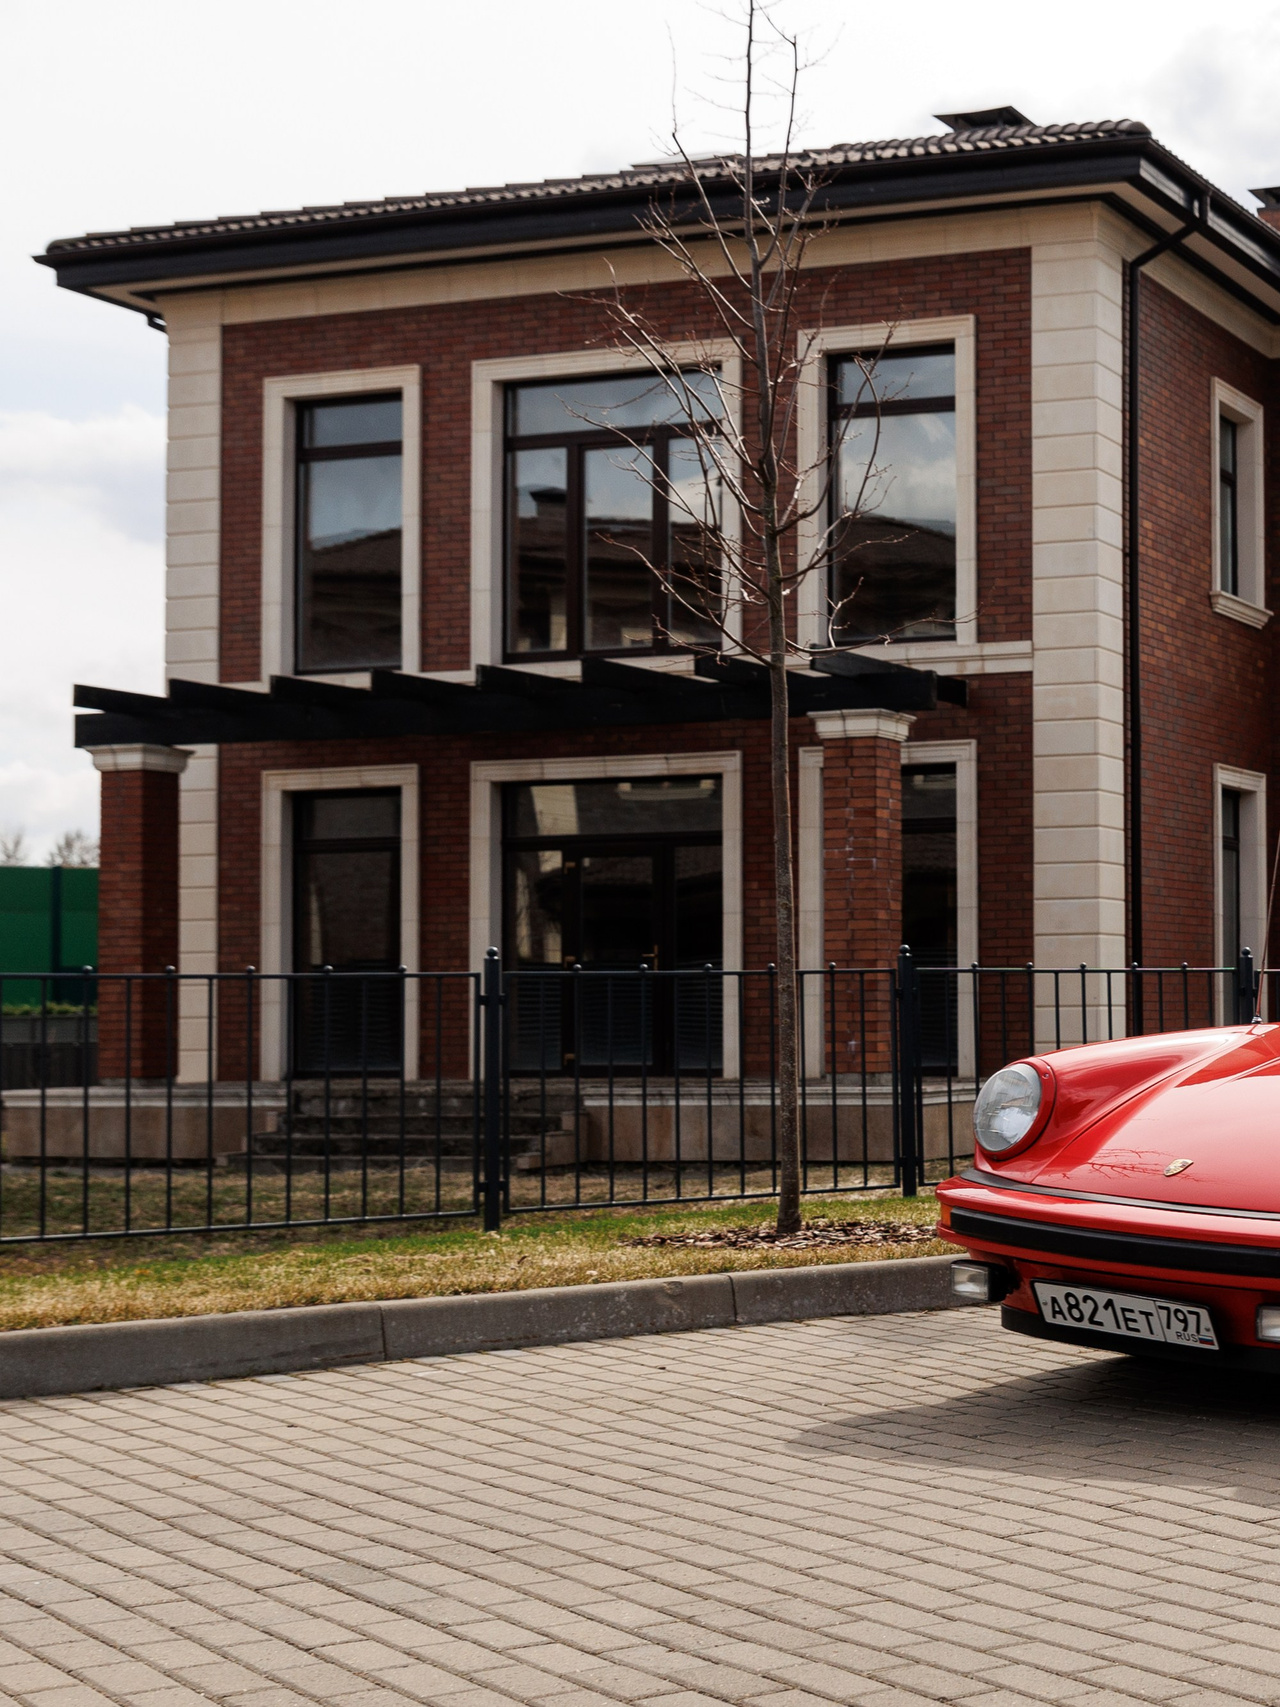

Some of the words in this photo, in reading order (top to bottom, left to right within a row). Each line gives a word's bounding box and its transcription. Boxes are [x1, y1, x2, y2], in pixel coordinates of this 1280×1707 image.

[1050, 1291, 1155, 1335] A821ET
[1157, 1304, 1201, 1335] 797
[1176, 1331, 1198, 1343] RUS
